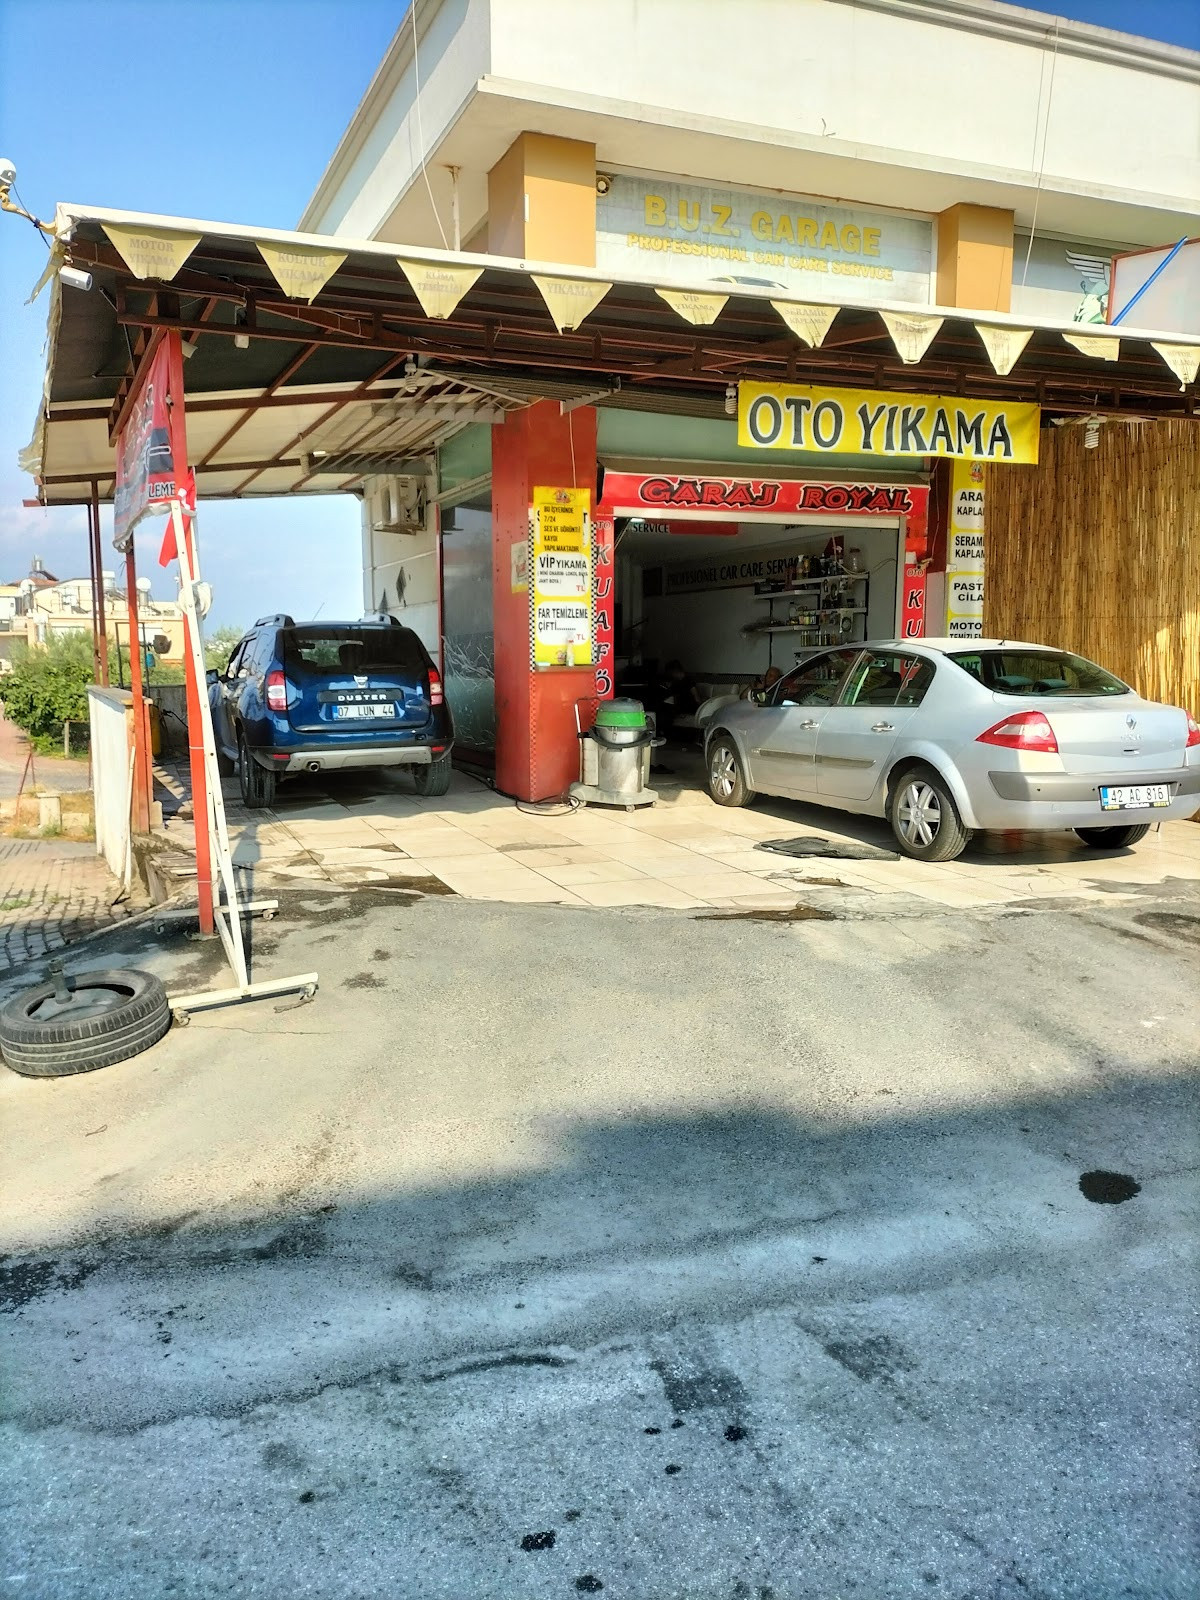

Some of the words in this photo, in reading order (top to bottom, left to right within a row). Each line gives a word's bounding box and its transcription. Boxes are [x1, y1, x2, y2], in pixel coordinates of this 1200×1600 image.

[644, 194, 740, 237] B.U.Z.
[751, 211, 881, 257] GARAGE
[129, 238, 175, 252] MOTOR
[129, 253, 176, 268] YIKAMA
[277, 252, 326, 267] KOLTUK
[627, 232, 750, 262] PROFESSIONAL
[753, 251, 785, 267] CAR
[790, 256, 828, 272] CARE
[831, 261, 893, 281] SERVICE
[277, 268, 326, 282] YIKAMA
[546, 282, 594, 298] YIKAMA
[748, 395, 844, 448] OTO
[858, 402, 1013, 457] YIKAMA
[640, 477, 782, 509] GARAJ
[797, 484, 913, 513] ROYAL
[544, 515, 556, 523] 7/24
[553, 525, 559, 533] VE
[633, 521, 671, 533] SERVICE
[539, 554, 556, 569] VİP
[556, 559, 587, 569] YIKAMA
[720, 564, 738, 580] CAR
[741, 560, 764, 578] CARE
[906, 568, 925, 577] OTO
[576, 584, 586, 592] TL
[538, 608, 551, 619] FAR
[552, 606, 589, 619] TEMİZLEME
[576, 633, 586, 641] TL
[337, 694, 387, 702] DUSTER
[338, 706, 349, 717] 07
[357, 706, 375, 717] LUN
[382, 705, 394, 716] 44
[1111, 789, 1123, 803] 42
[1147, 787, 1164, 800] 816
